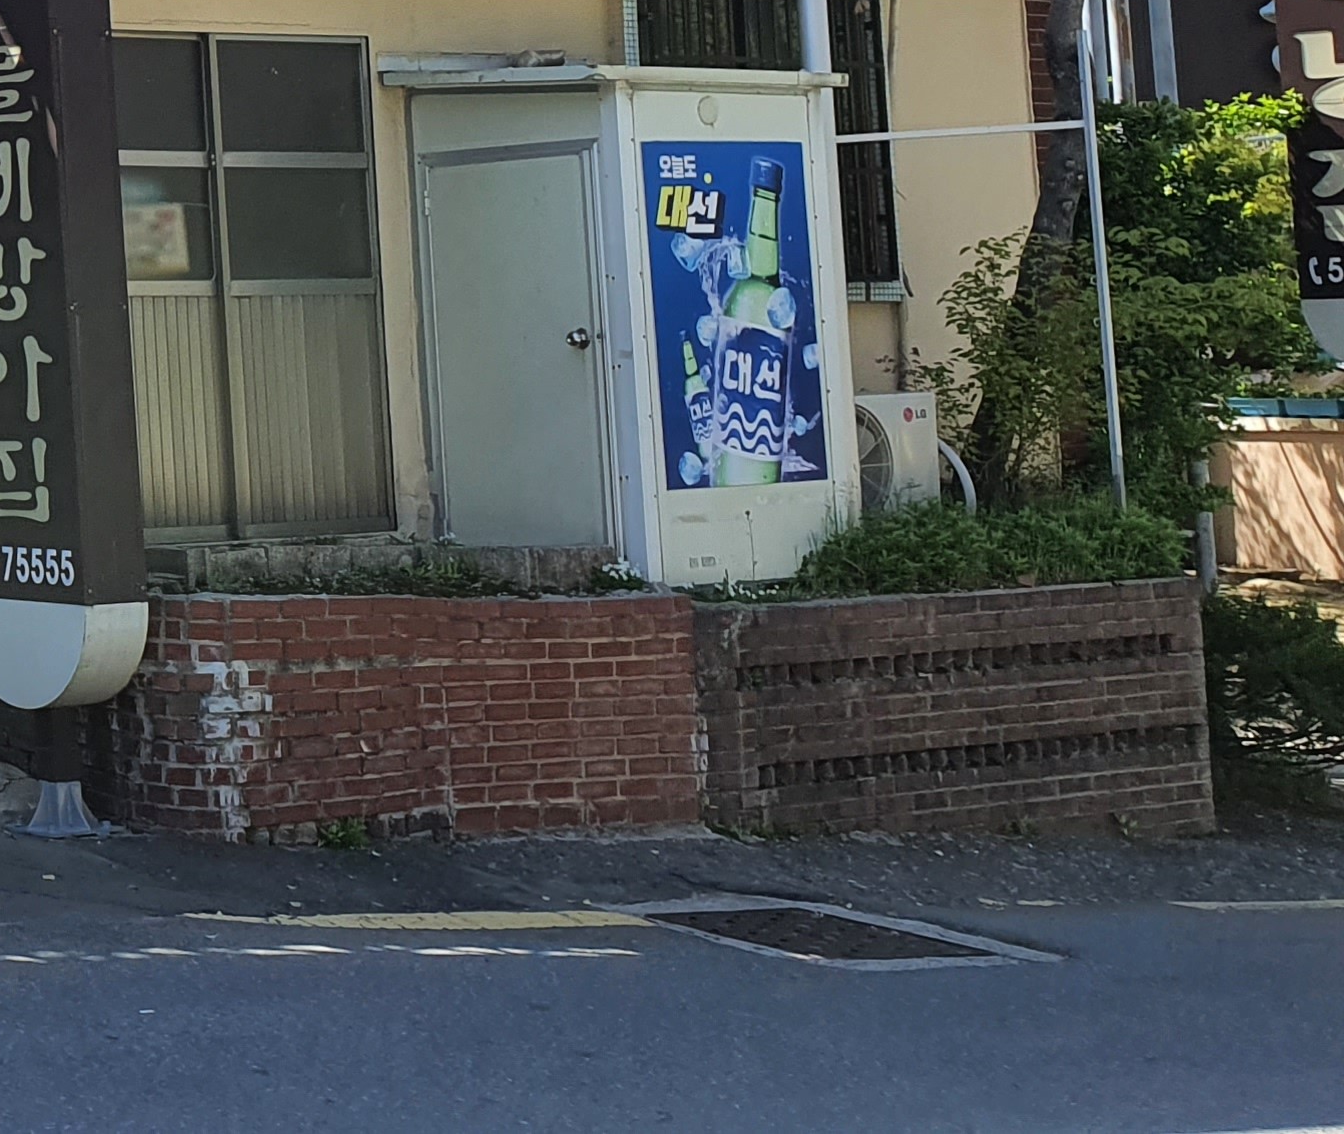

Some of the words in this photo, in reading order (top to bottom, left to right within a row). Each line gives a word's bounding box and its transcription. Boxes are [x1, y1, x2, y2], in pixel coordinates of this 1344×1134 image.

[659, 155, 697, 179] 오늘도
[656, 185, 719, 234] 대선
[723, 349, 782, 403] 대선
